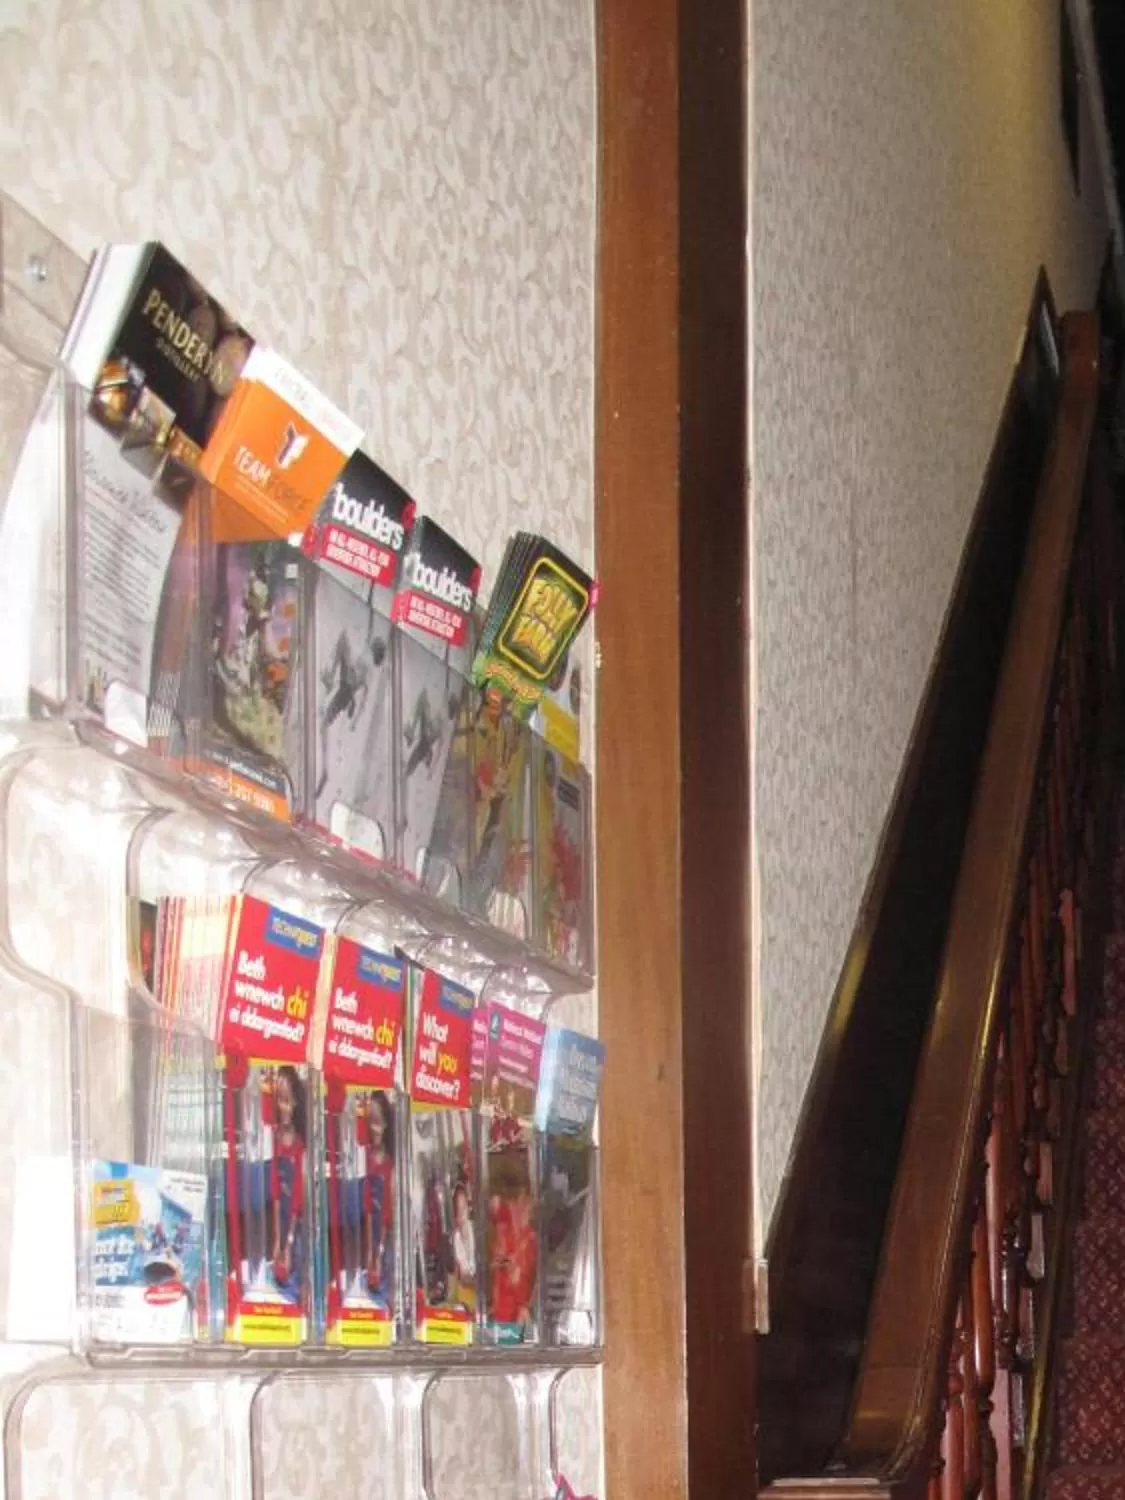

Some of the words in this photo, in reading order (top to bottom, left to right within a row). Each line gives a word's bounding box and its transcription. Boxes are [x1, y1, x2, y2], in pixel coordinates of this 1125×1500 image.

[142, 288, 224, 386] PENDERYN
[332, 482, 404, 550] boulders
[412, 554, 472, 612] boulders
[237, 949, 266, 981] Beth
[234, 980, 285, 1012] wnewch
[286, 984, 310, 1020] chi
[335, 987, 359, 1015] Beth
[375, 1017, 396, 1048] chi
[423, 1012, 449, 1044] What
[419, 1041, 437, 1066] will
[437, 1051, 457, 1077] you
[415, 1064, 461, 1100] discover?
